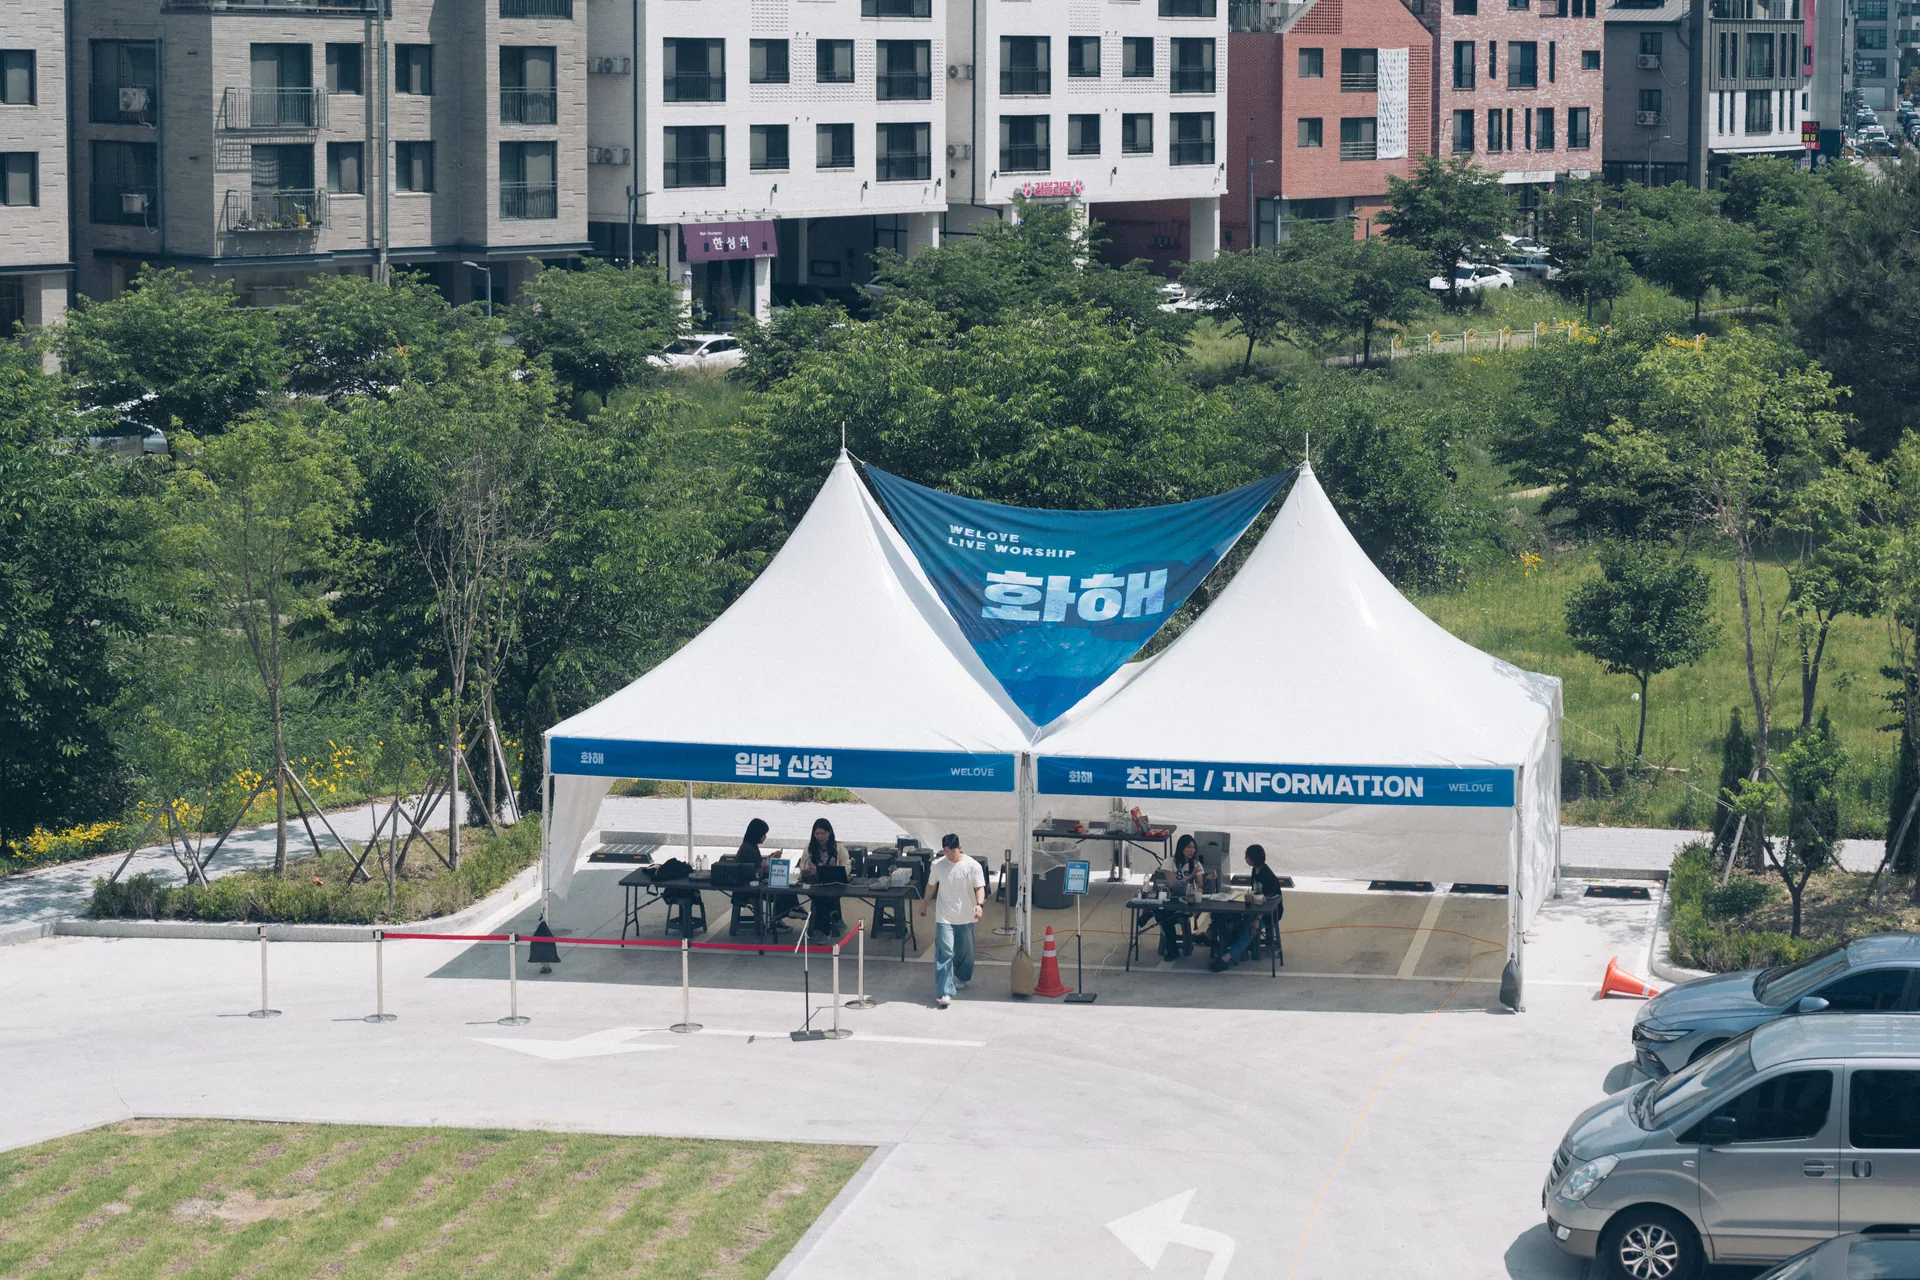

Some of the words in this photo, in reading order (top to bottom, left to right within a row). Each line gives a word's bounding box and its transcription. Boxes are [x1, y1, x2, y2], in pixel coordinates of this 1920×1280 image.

[949, 524, 1020, 544] WELOVE
[948, 536, 987, 551] LIVE
[994, 543, 1077, 559] WORSHIP
[981, 568, 1168, 622] 화해
[580, 751, 605, 765] 화해
[734, 752, 782, 777] 일반
[787, 754, 833, 779] 신청
[950, 767, 995, 778] WELOVE
[1068, 770, 1094, 784] 화해
[1126, 766, 1196, 792] 초대권
[1222, 771, 1424, 797] INFORMATION
[1448, 782, 1494, 793] WELOVE
